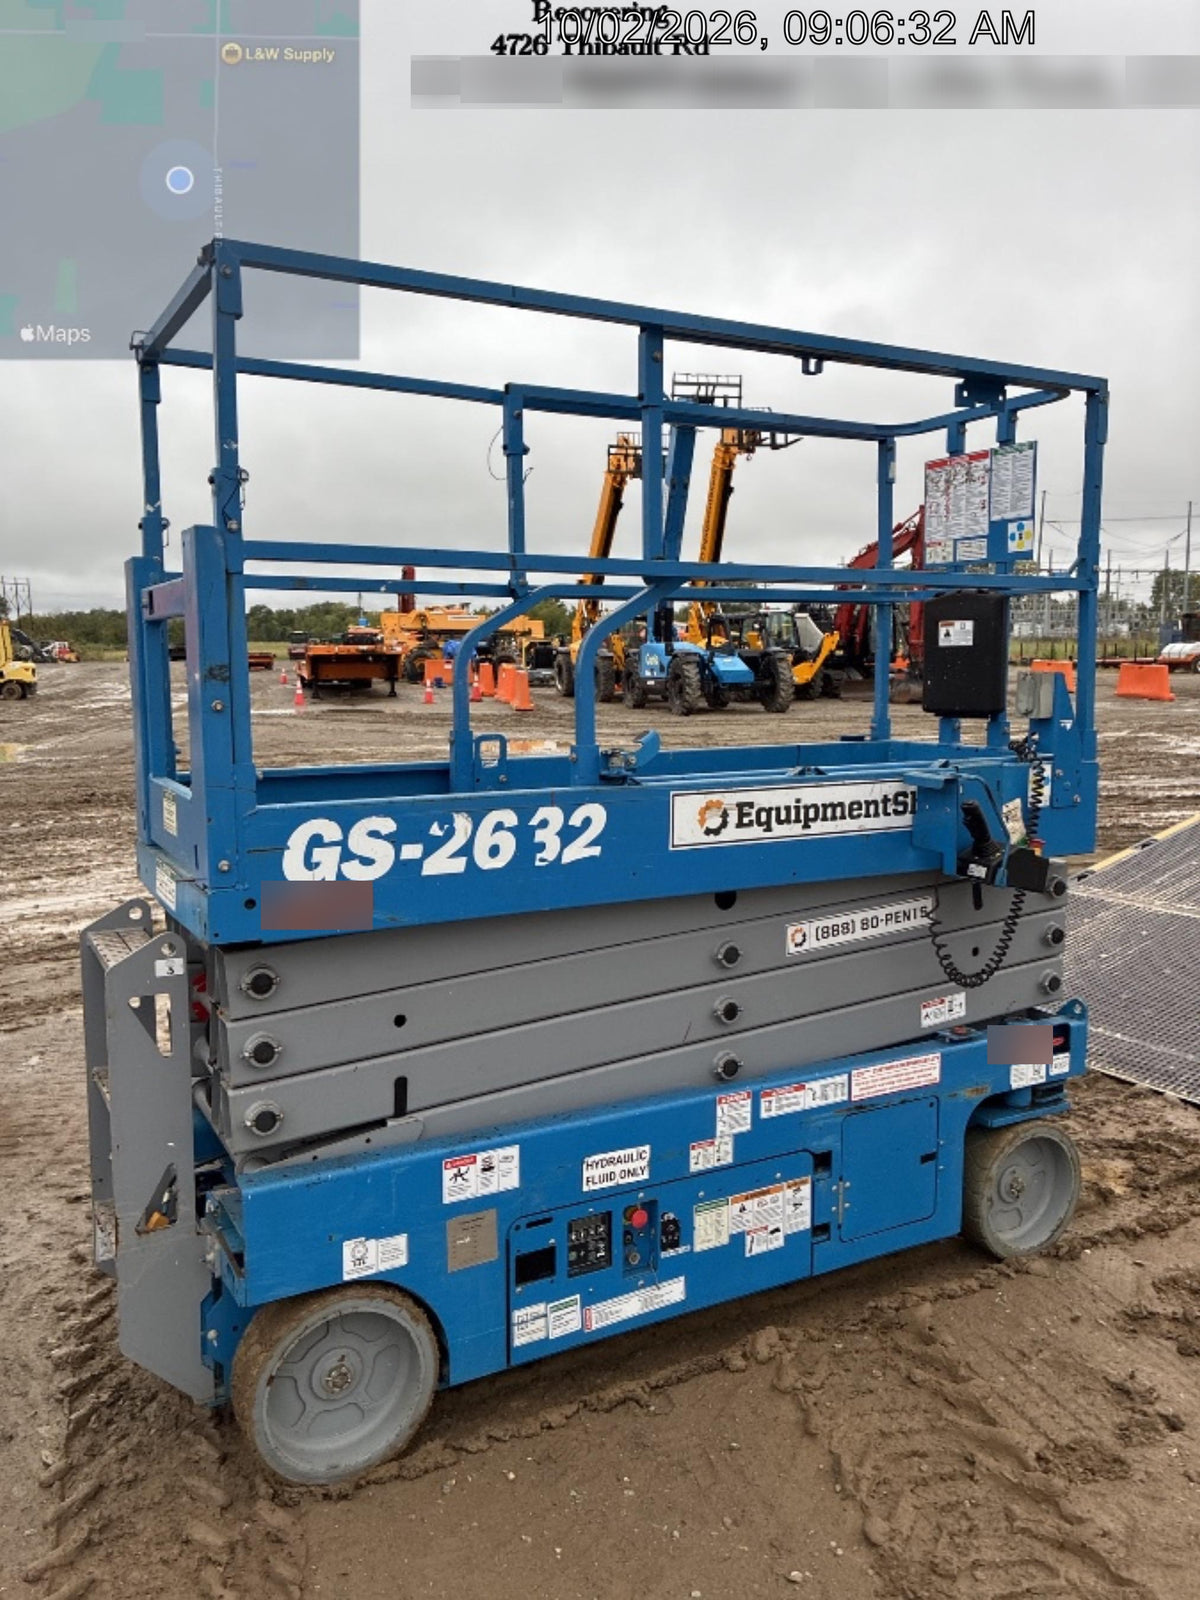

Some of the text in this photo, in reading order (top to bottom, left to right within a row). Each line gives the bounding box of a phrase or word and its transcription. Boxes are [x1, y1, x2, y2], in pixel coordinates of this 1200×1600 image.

[585, 1149, 648, 1171] HYDRAULIC
[585, 1165, 647, 1187] FLUID ONLY
